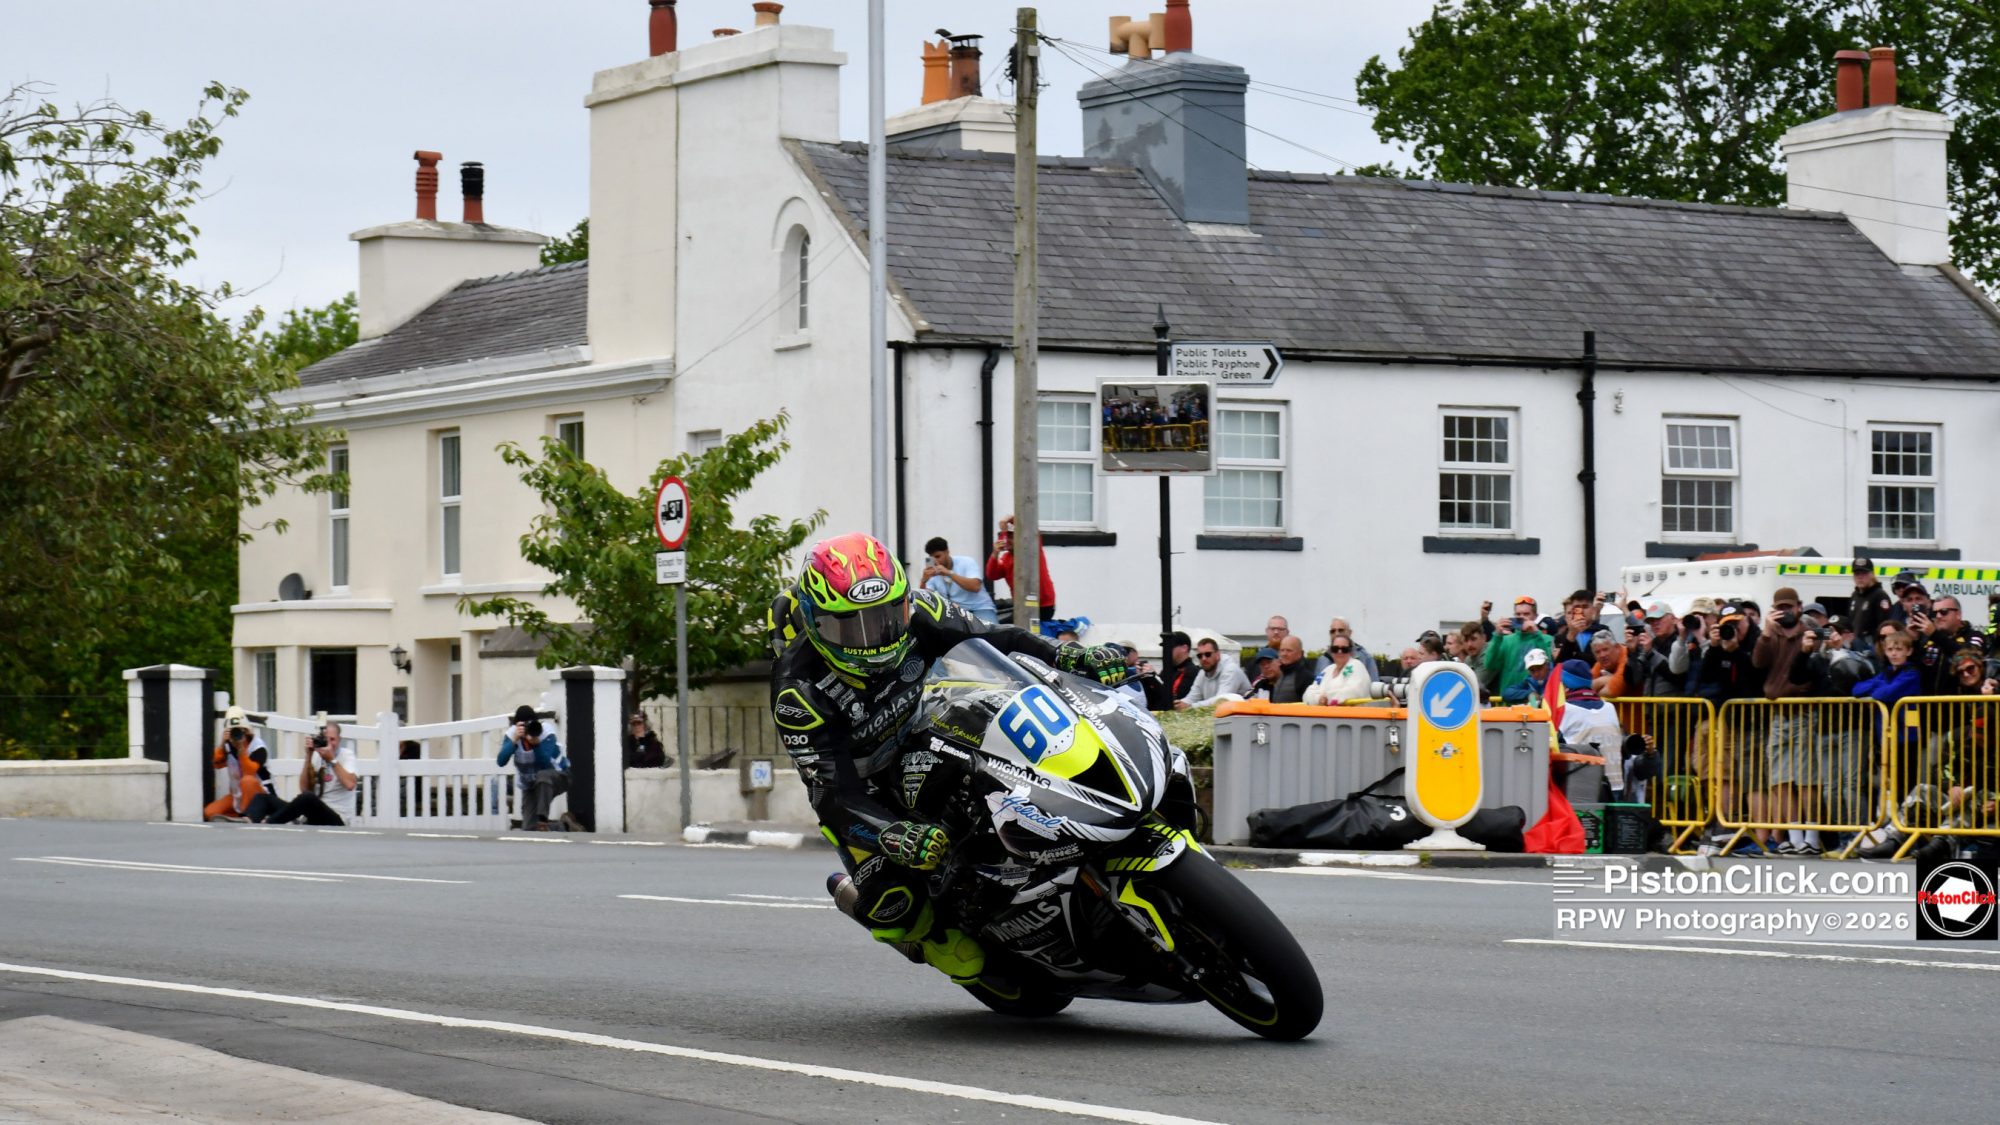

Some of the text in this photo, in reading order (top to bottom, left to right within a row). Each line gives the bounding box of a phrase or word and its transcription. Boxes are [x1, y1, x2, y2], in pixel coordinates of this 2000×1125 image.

[1175, 348, 1248, 358] Public Toilets
[1175, 360, 1261, 371] Public Payphone
[1220, 370, 1253, 380] Green
[857, 581, 884, 597] Arai
[843, 647, 877, 656] SUSTAIN
[879, 641, 900, 653] Racing
[774, 703, 812, 719] RST
[852, 684, 922, 741] WIGNALL
[998, 686, 1071, 764] 60
[987, 757, 1051, 789] WIGNALLS
[993, 796, 1063, 829] Helical
[1029, 845, 1080, 865] BARNES
[985, 901, 1061, 943] WIGNALLS
